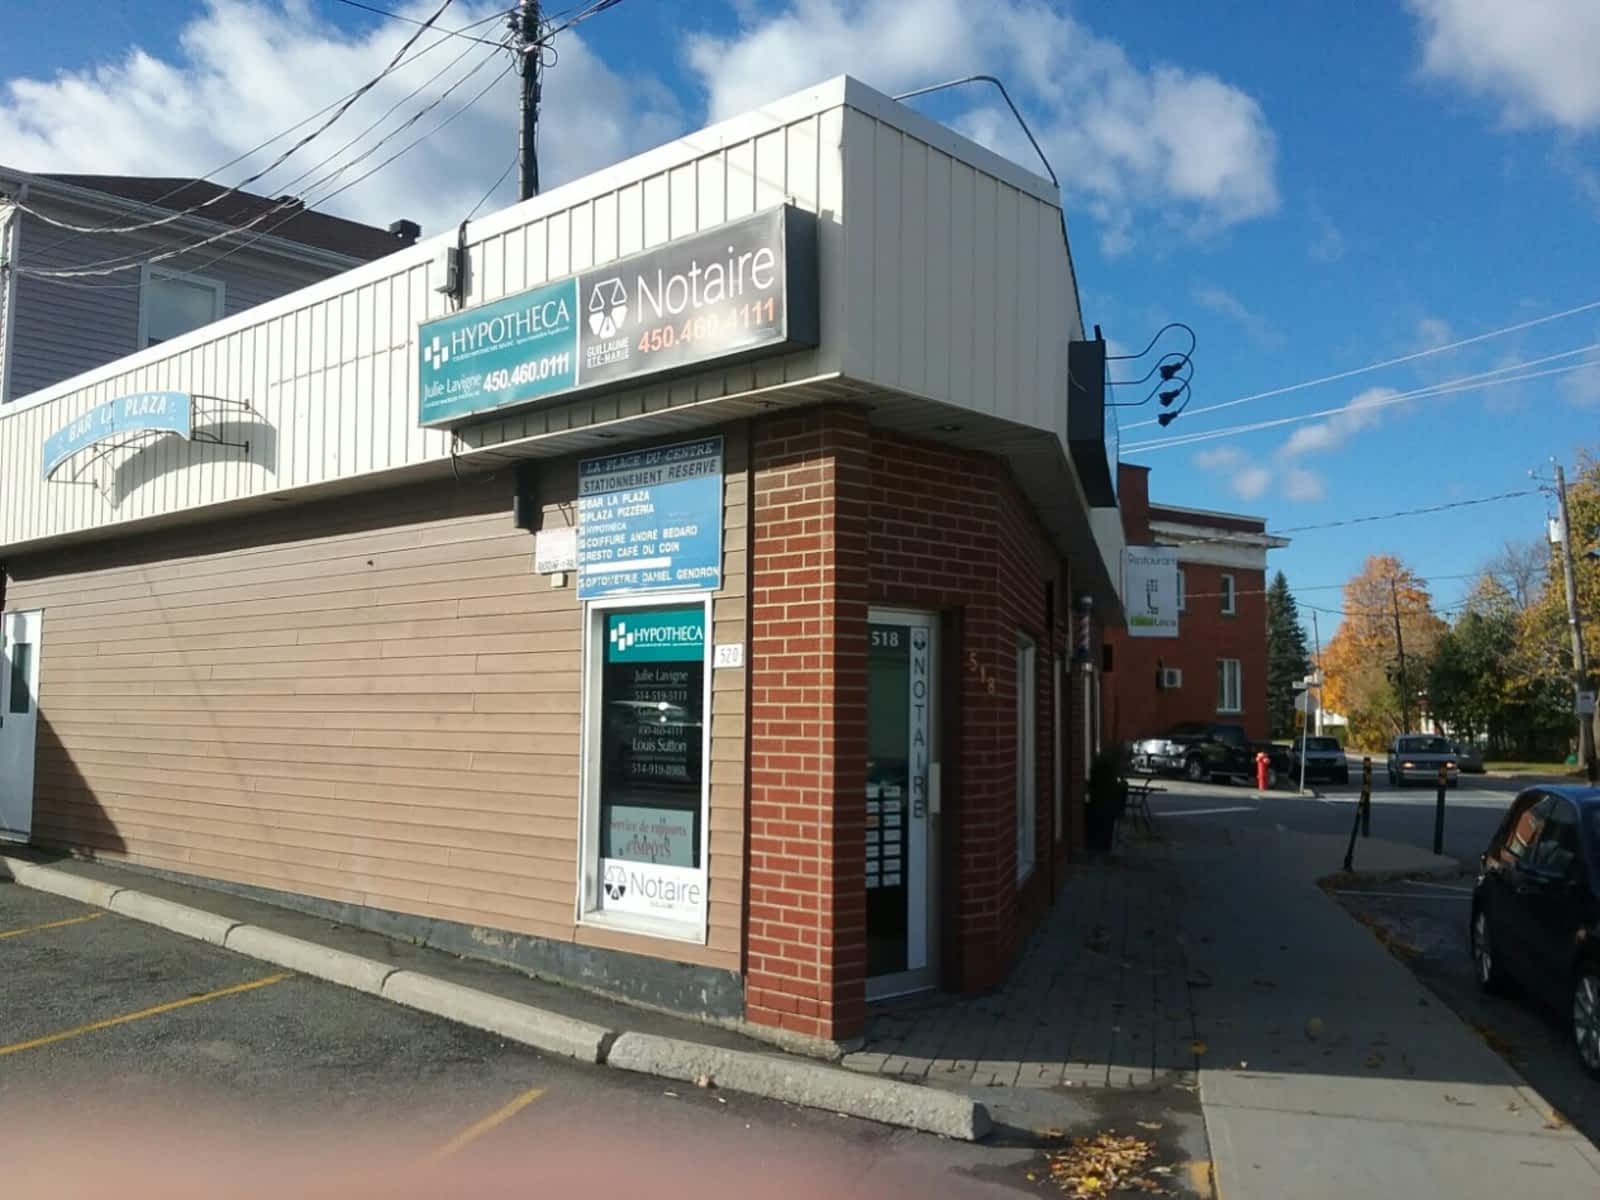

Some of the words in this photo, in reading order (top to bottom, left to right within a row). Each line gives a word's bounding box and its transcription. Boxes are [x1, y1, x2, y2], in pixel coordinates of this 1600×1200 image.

[637, 246, 775, 324] Notaire
[452, 298, 570, 355] HYPOTHECA
[483, 352, 569, 392] 450.460.0111
[424, 381, 445, 401] Julie
[446, 374, 481, 394] Lavigne
[69, 414, 92, 442] BAR
[124, 395, 167, 416] PLAZA
[586, 463, 600, 473] LA
[606, 456, 640, 471] PLACE
[646, 452, 660, 464] DU
[665, 443, 713, 460] CENTRE
[583, 470, 662, 493] STATIONNEMENT
[608, 496, 618, 506] LA
[622, 490, 650, 504] PLAZA
[587, 509, 613, 524] PLAZA
[586, 549, 612, 561] RESTO
[642, 544, 654, 555] DU
[660, 541, 680, 553] COIN
[587, 534, 625, 548] COIFFURE
[677, 566, 720, 579] GENDRON
[634, 625, 703, 643] HYPOTHECA
[871, 631, 899, 647] 518
[720, 647, 739, 664] 520
[632, 737, 656, 752] Louis
[913, 658, 926, 819] NOTAIRE
[631, 871, 700, 905] Notaire
